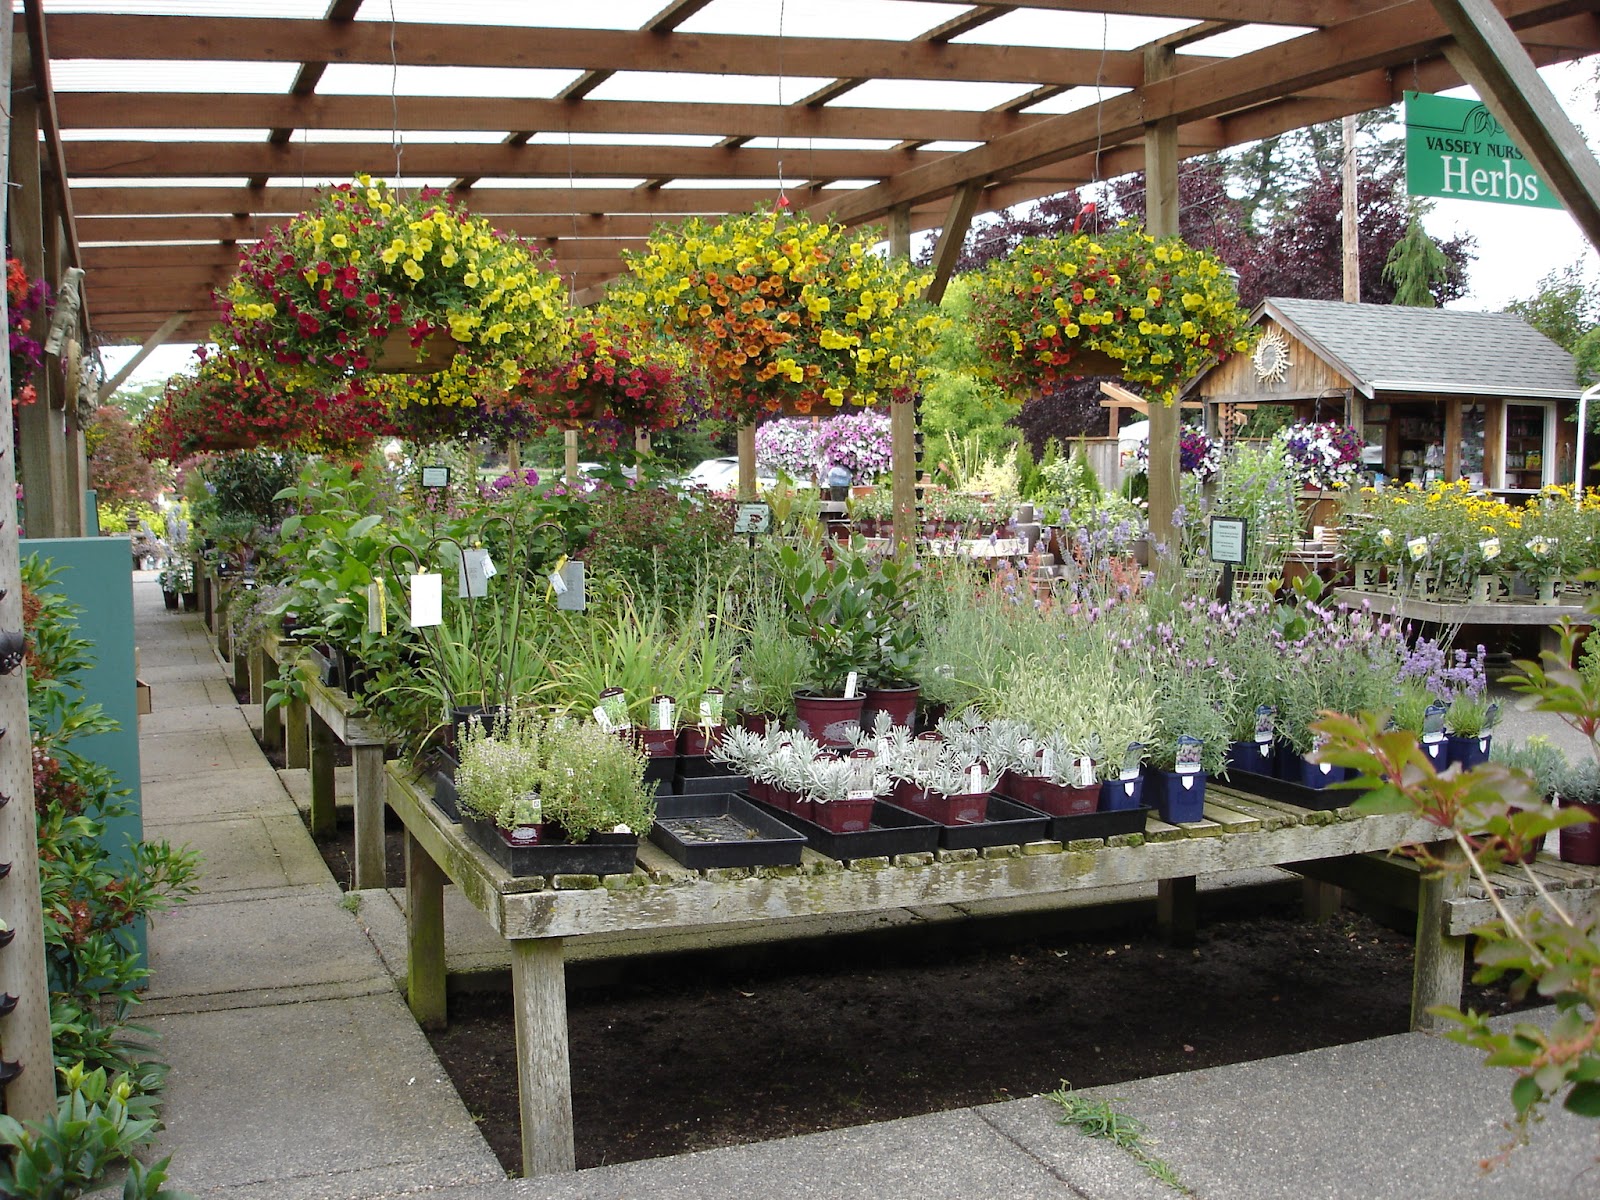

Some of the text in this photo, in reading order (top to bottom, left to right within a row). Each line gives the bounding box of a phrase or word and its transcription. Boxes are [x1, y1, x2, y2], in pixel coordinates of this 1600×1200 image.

[1426, 137, 1526, 160] VASSEY NURS
[1441, 155, 1538, 201] Herbs
